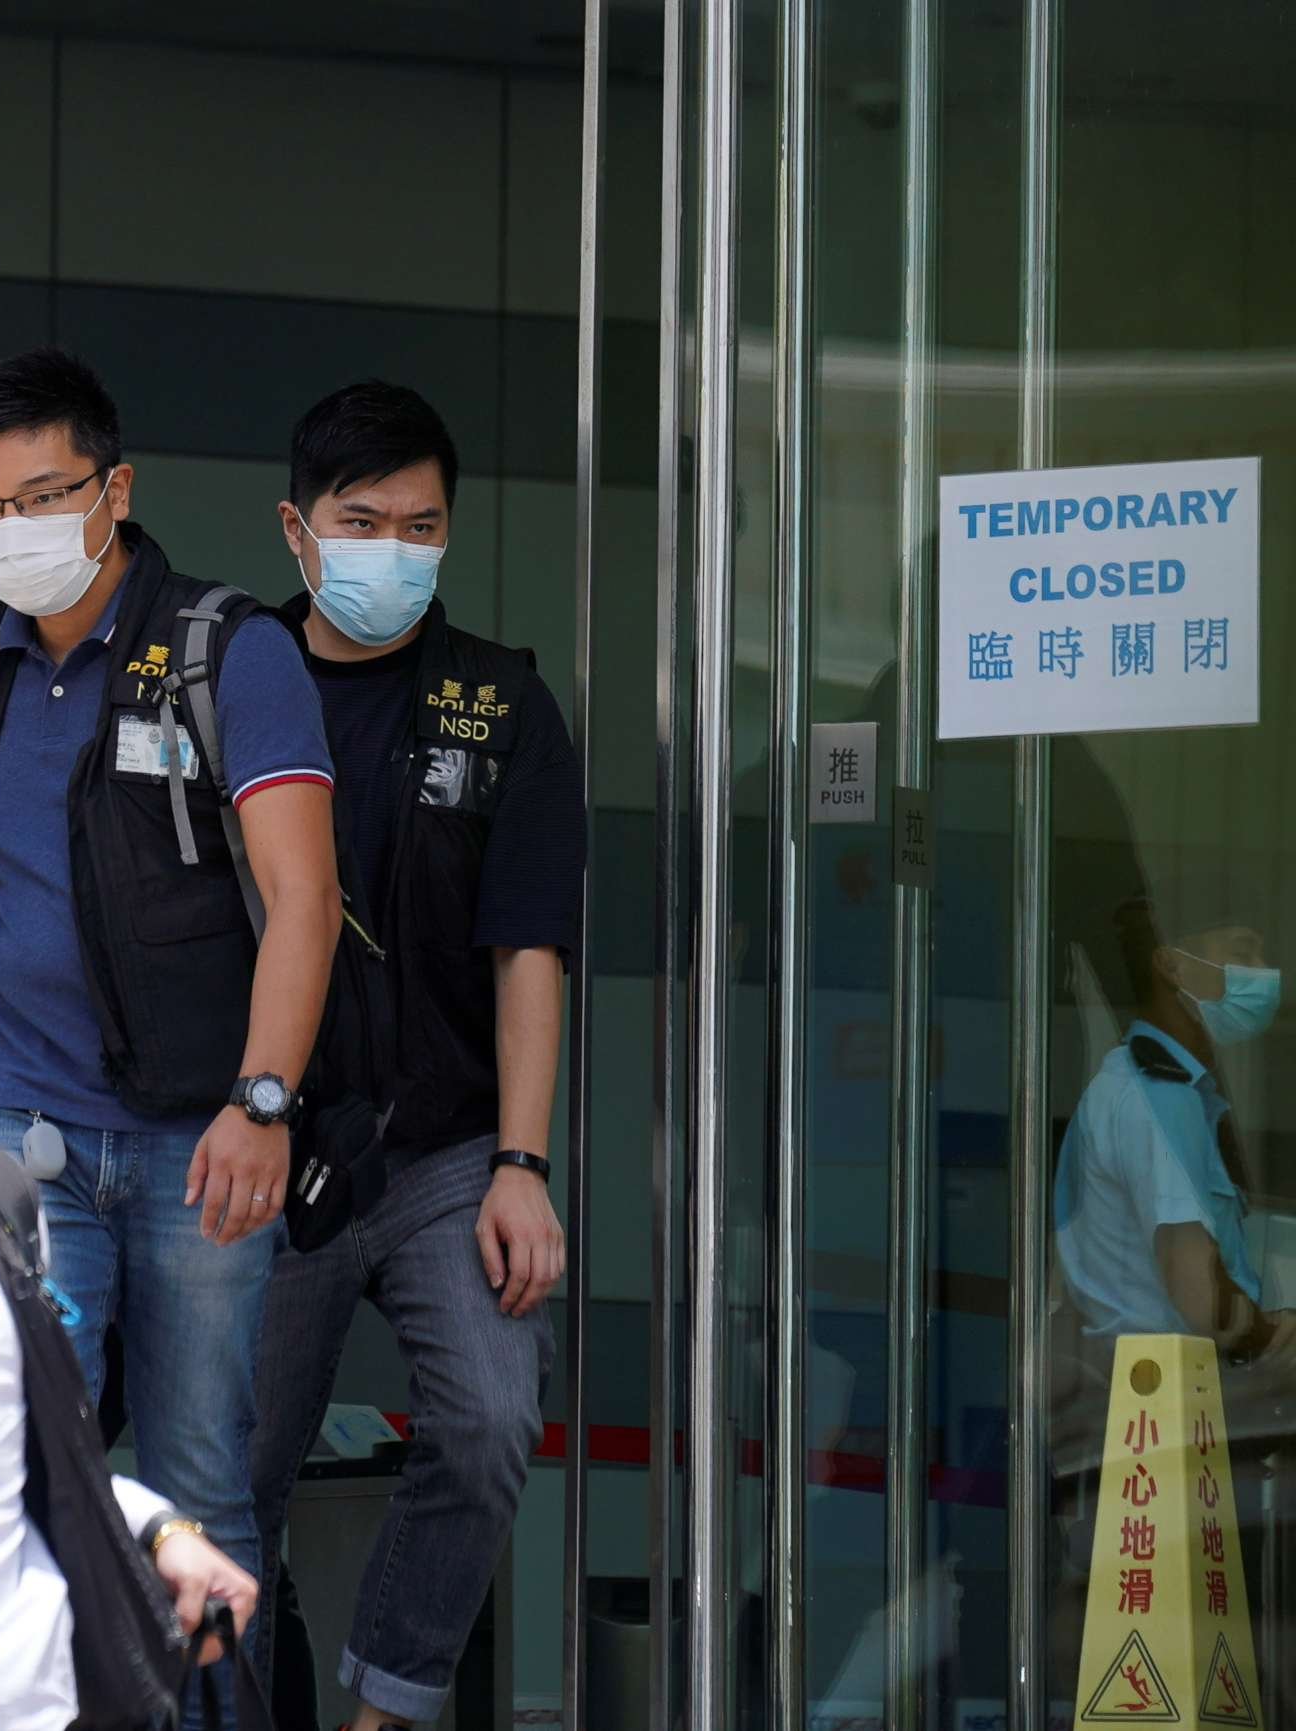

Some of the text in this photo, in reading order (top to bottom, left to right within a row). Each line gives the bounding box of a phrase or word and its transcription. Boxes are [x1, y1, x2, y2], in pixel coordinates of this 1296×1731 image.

[959, 487, 1238, 539] TEMPORARY
[1009, 559, 1186, 603] CLOSED
[968, 617, 1229, 681] 臨時關閉
[442, 679, 497, 703] 警察
[440, 714, 489, 741] NSD
[829, 748, 859, 785] 推
[821, 790, 865, 805] PUSH
[906, 808, 925, 845] 拉
[902, 849, 928, 866] PULL
[1118, 1410, 1159, 1616] 小心地滑
[1194, 1409, 1229, 1617] 小心地滑
